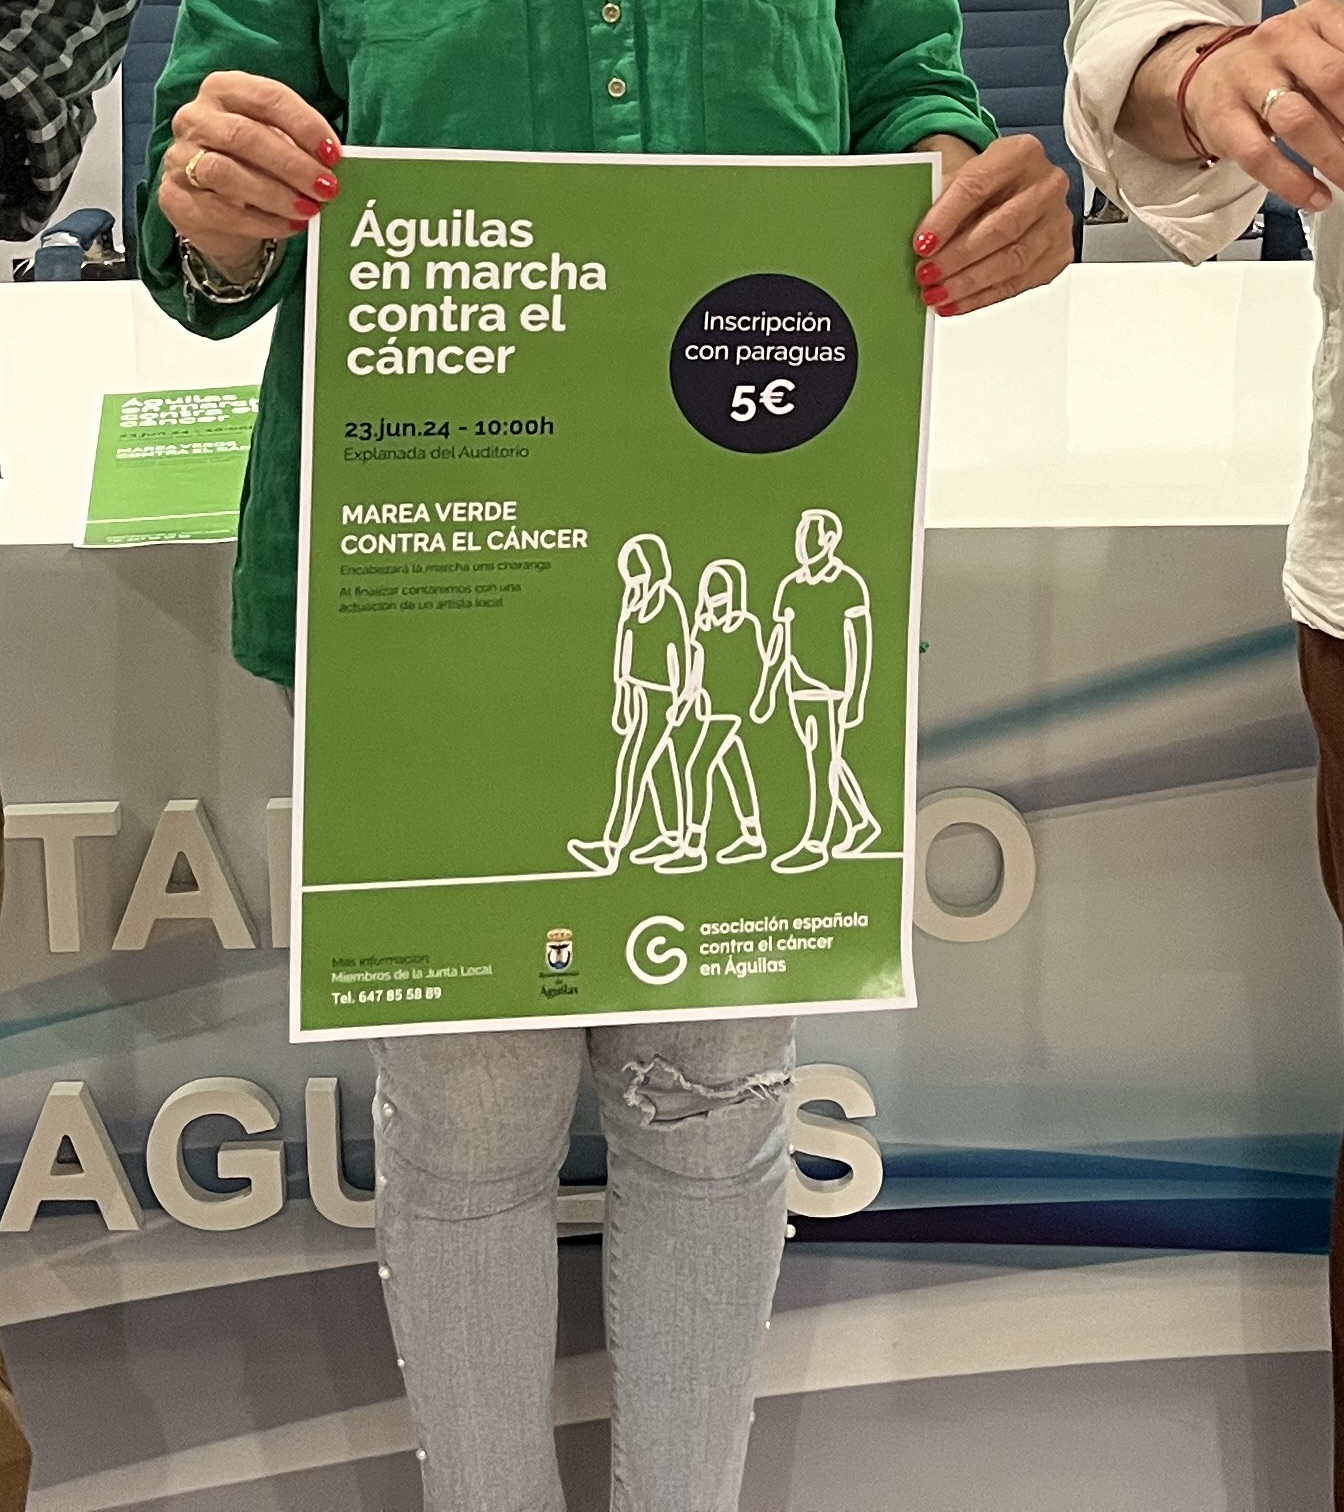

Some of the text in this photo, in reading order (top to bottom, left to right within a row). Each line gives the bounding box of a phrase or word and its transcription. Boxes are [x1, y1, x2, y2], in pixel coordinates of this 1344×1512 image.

[350, 199, 534, 257] Águilas
[349, 252, 607, 291] en marcha
[348, 294, 566, 333] contra el
[703, 311, 831, 336] Inscripción
[347, 337, 516, 375] cáncer
[684, 344, 846, 366] con paraguas
[730, 378, 796, 422] 5€
[344, 418, 450, 442] 23.jun.24
[475, 416, 554, 436] 10:00h
[344, 445, 530, 464] Explanada del Auditorio
[342, 501, 517, 525] MAREA VERDE
[341, 526, 588, 555] CONTRA EL CÁNCER
[700, 911, 869, 935] asociación española
[699, 934, 834, 955] contra el cáncer
[700, 955, 786, 978] en Águilas
[332, 991, 356, 1005] Tel.
[358, 990, 383, 1004] 647
